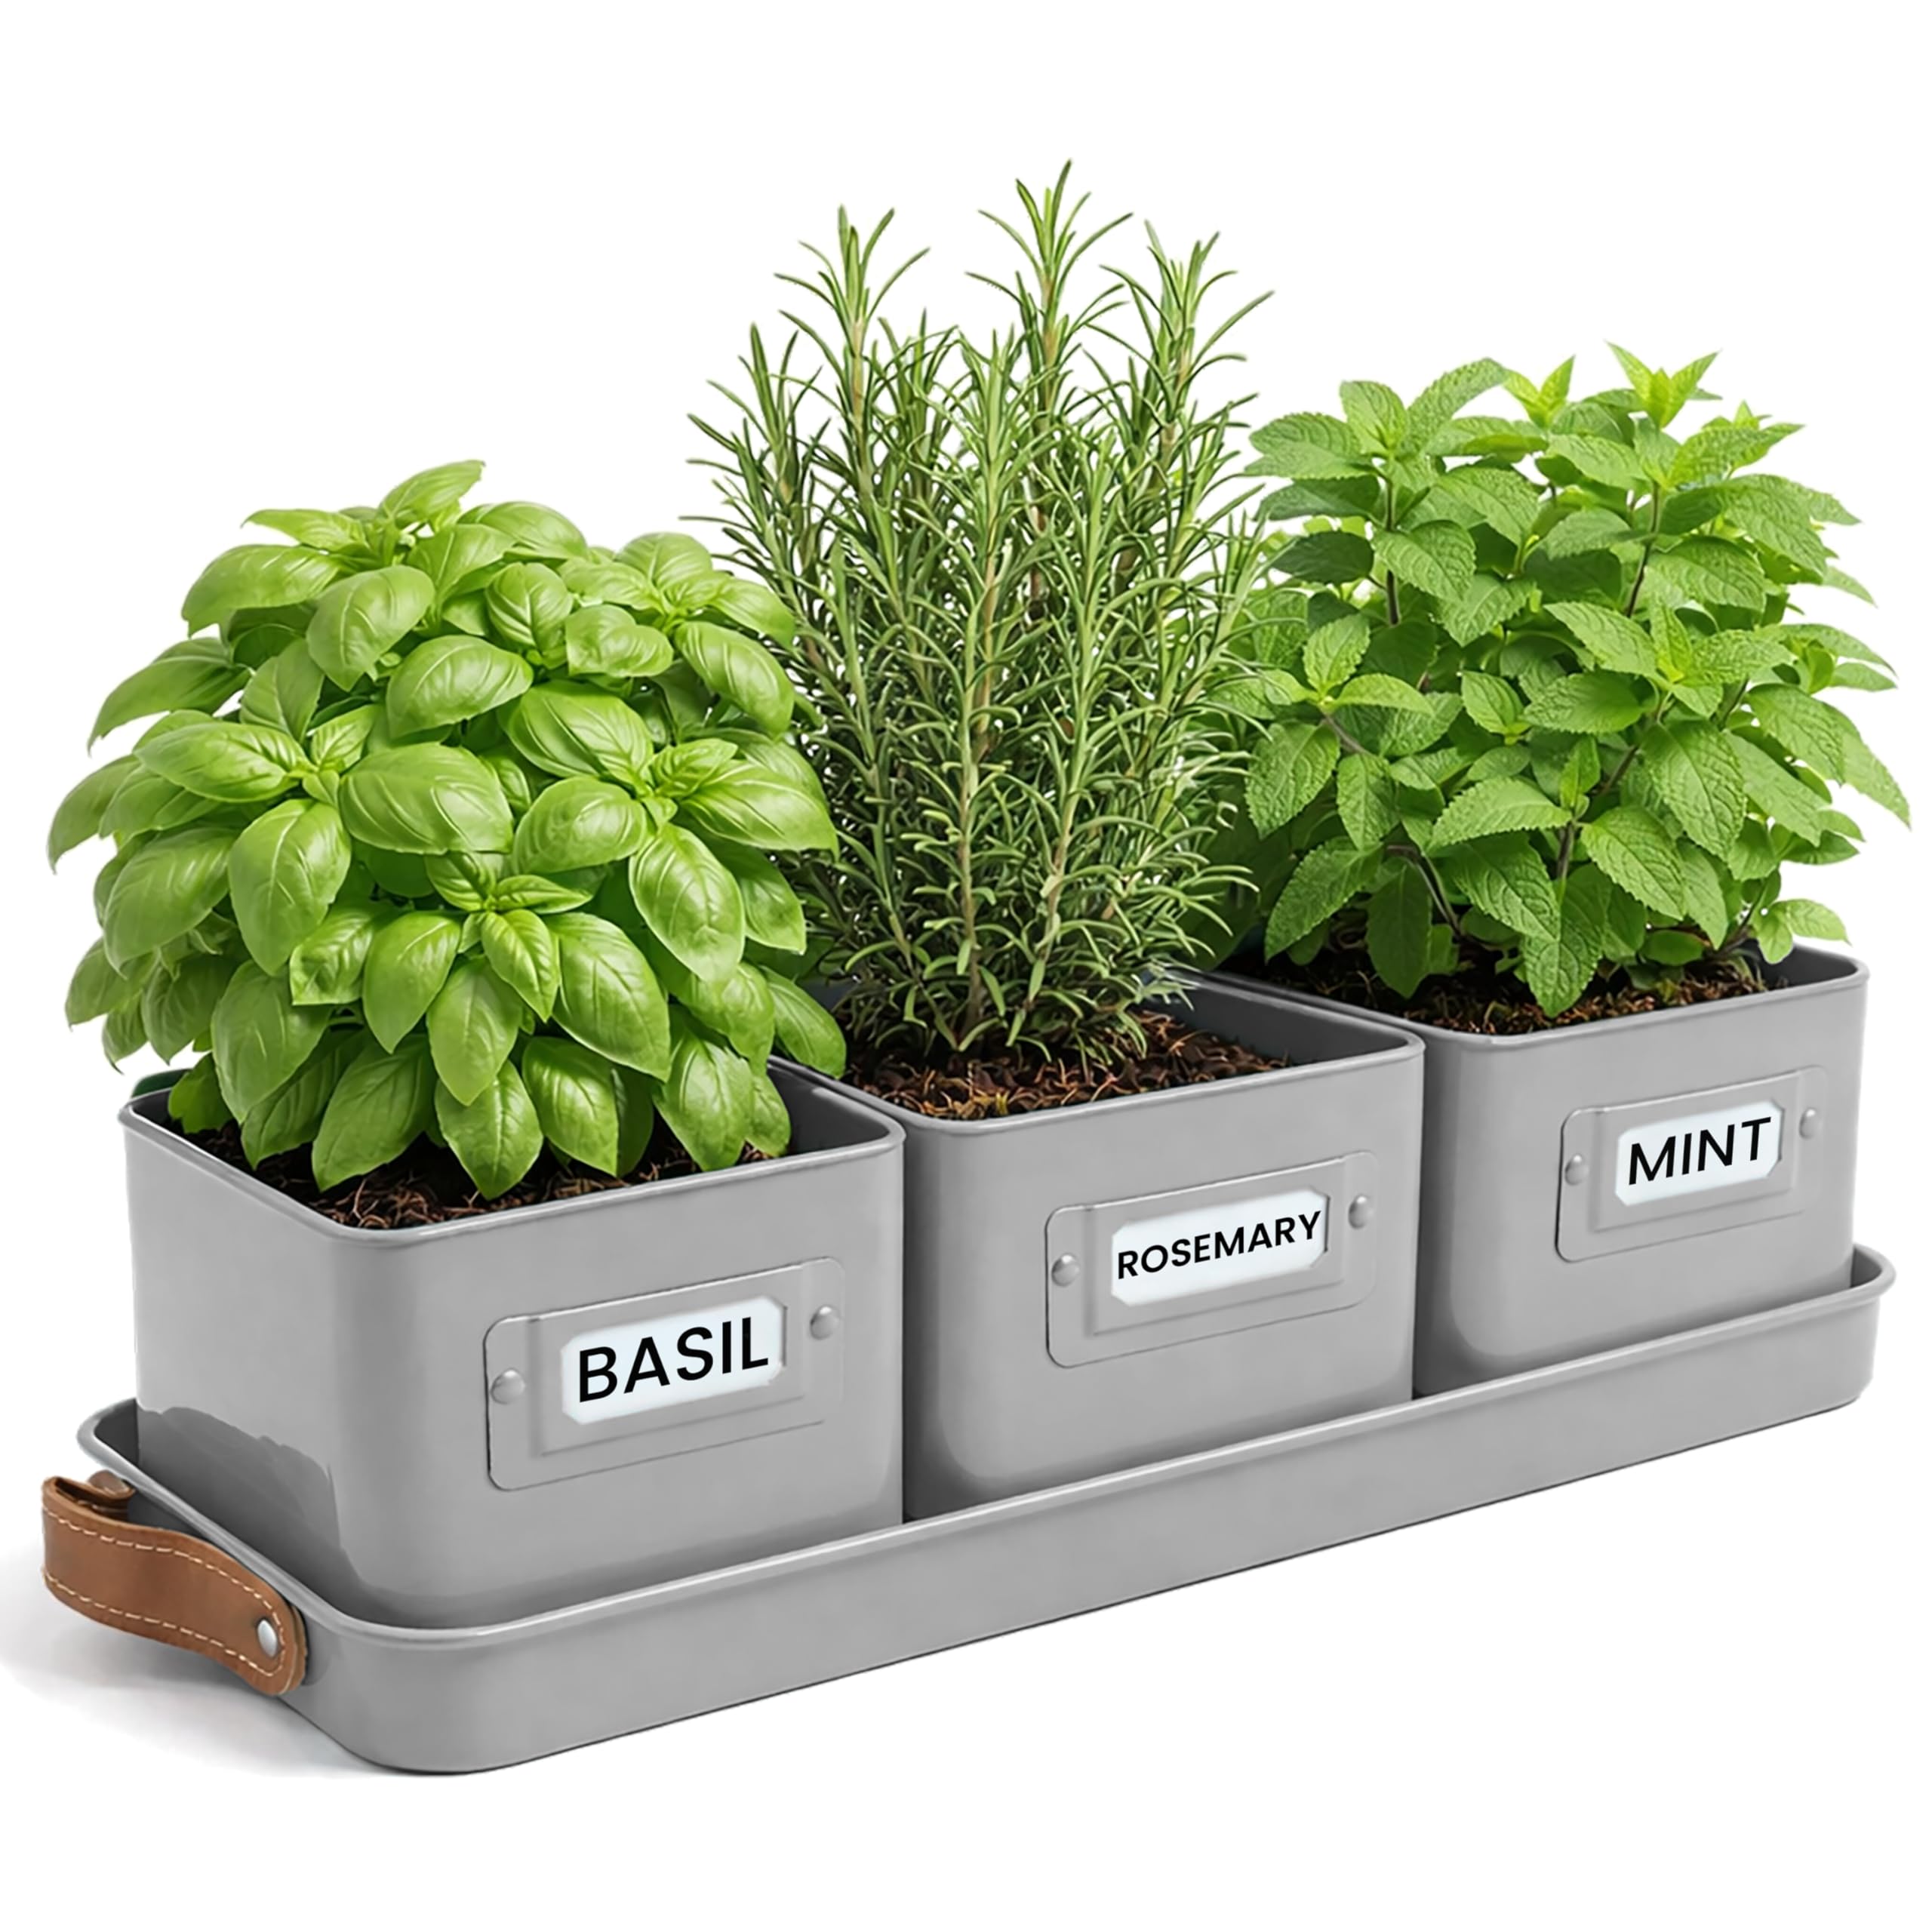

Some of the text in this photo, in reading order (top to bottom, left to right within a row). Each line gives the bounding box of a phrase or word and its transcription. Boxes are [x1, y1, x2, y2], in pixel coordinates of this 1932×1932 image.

[1629, 1117, 1771, 1185] MINT
[1118, 1211, 1321, 1279] ROSEMARY
[580, 1317, 768, 1402] BASIL
